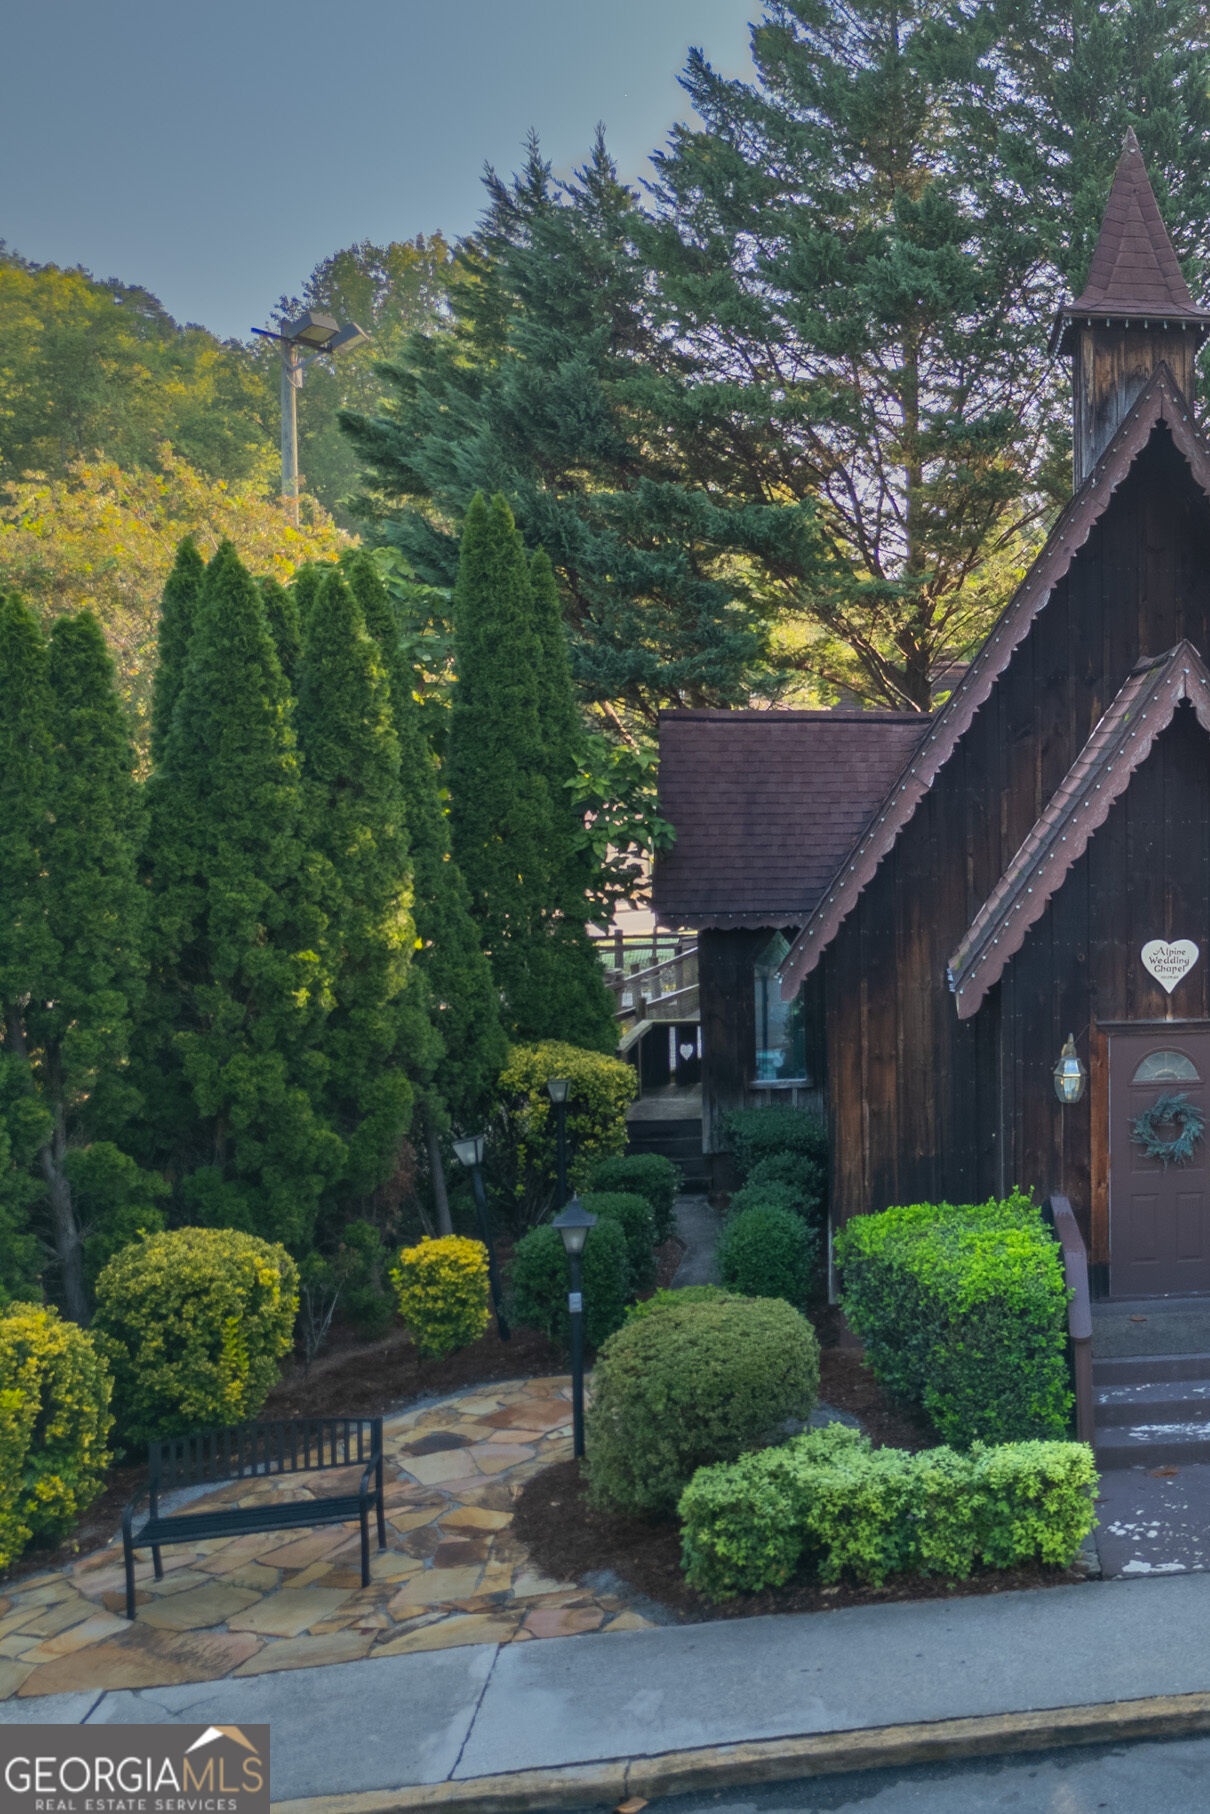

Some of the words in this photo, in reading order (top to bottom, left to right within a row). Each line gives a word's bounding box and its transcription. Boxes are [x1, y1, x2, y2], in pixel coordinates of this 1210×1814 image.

[1153, 947, 1186, 957] Alpine
[1149, 956, 1190, 967] Wedding
[1154, 965, 1186, 975] Chapel
